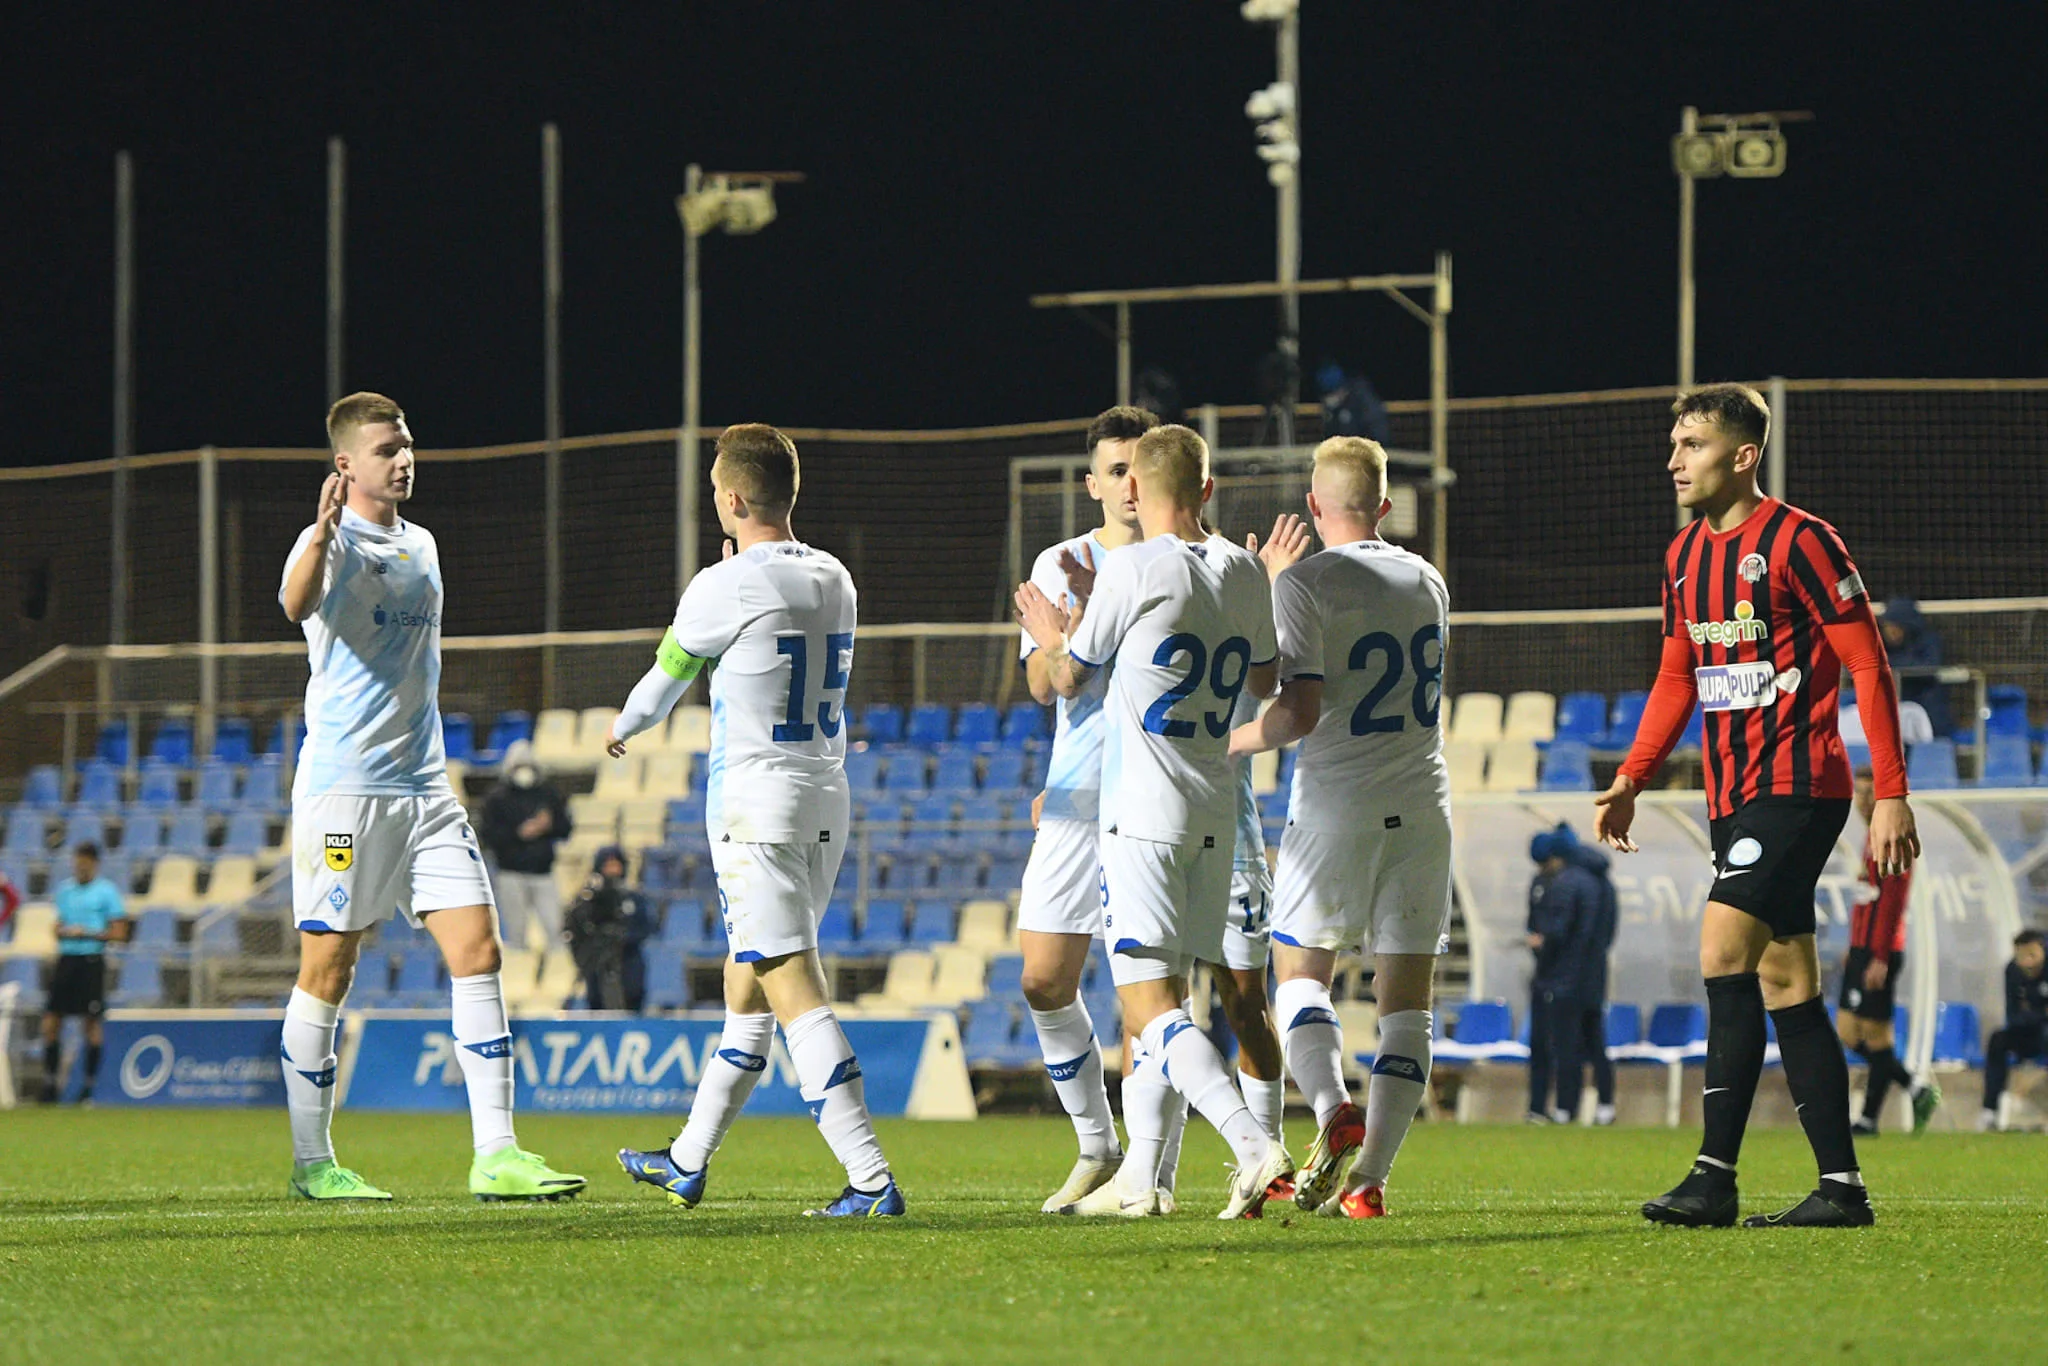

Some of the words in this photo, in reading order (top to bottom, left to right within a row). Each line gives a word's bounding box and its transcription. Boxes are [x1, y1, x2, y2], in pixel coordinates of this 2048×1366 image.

[1348, 624, 1442, 736] 28
[1685, 606, 1768, 648] eregrin
[773, 633, 853, 741] 15
[1143, 633, 1250, 738] 29
